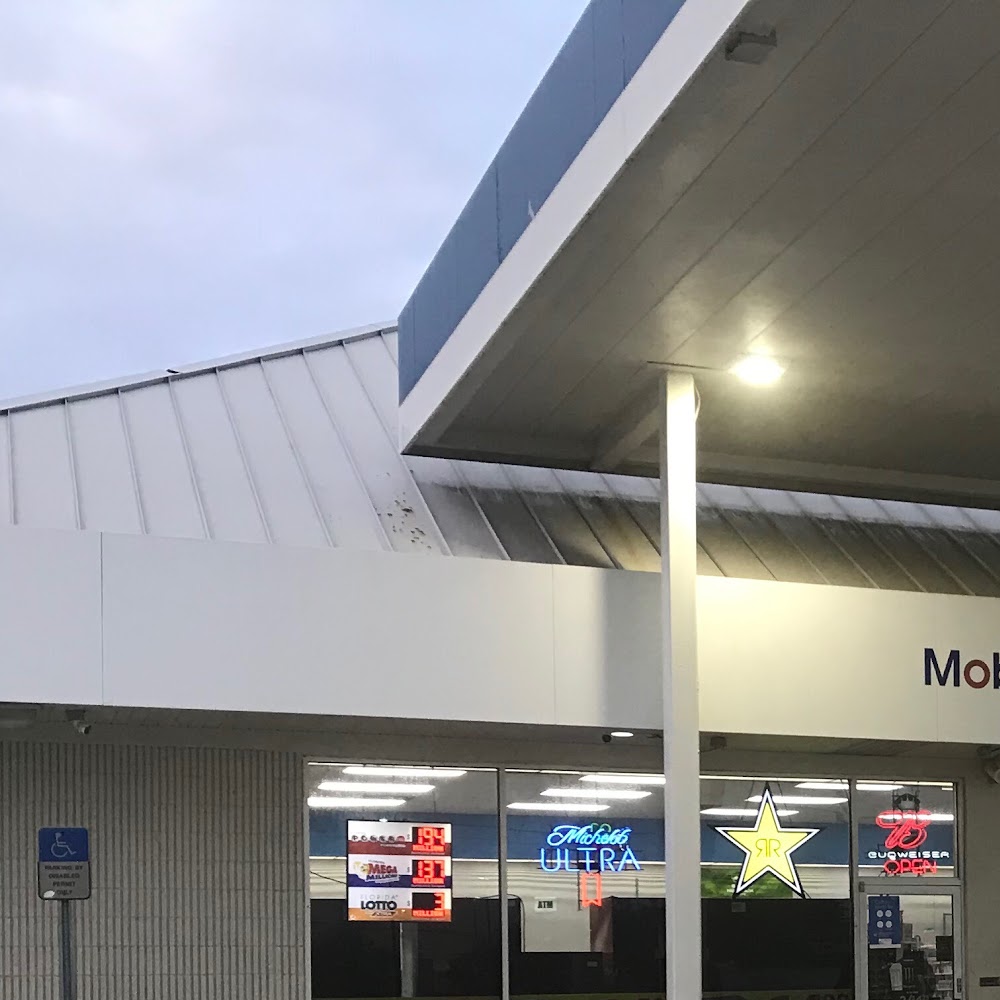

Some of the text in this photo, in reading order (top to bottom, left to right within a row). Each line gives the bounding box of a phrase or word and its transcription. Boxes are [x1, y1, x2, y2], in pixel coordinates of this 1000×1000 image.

[418, 827, 445, 846] 194
[540, 846, 641, 873] ULTRA
[883, 859, 938, 875] OPEN
[367, 863, 398, 875] MEGA
[418, 860, 445, 878] 137
[361, 901, 398, 910] LOTTO
[433, 892, 445, 910] 3
